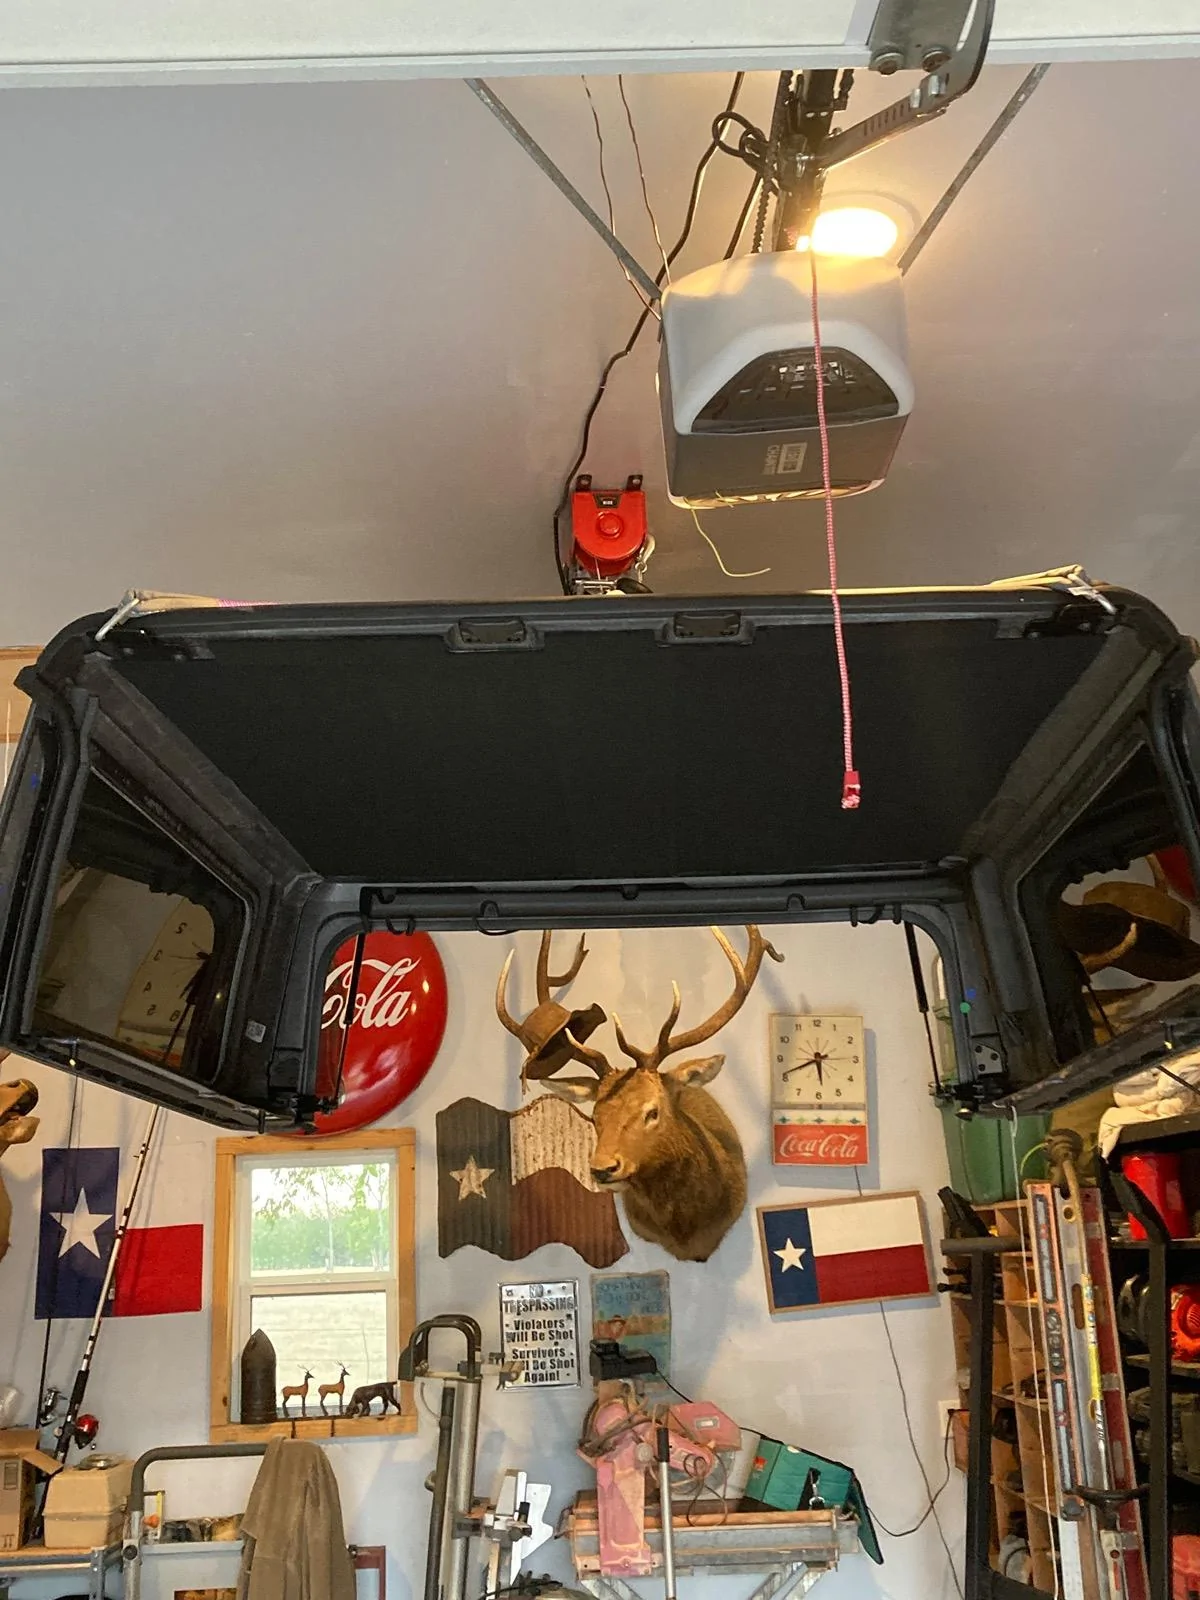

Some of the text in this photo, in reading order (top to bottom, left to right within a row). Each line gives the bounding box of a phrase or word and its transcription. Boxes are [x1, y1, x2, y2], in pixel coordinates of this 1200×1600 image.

[813, 1019, 822, 1028] 12
[780, 1036, 790, 1044] 10
[847, 1036, 853, 1044] 2
[777, 1055, 784, 1063] 9
[852, 1055, 860, 1064] 3
[796, 1088, 801, 1096] 7
[815, 1092, 822, 1100] 6
[835, 1088, 842, 1097] 5
[529, 1284, 544, 1298] NO
[514, 1319, 565, 1330] Violators
[506, 1329, 574, 1343] Will Be Shot
[512, 1348, 566, 1359] Survivors
[533, 1360, 546, 1370] Be
[549, 1358, 575, 1369] Shot
[524, 1370, 560, 1383] Again!
